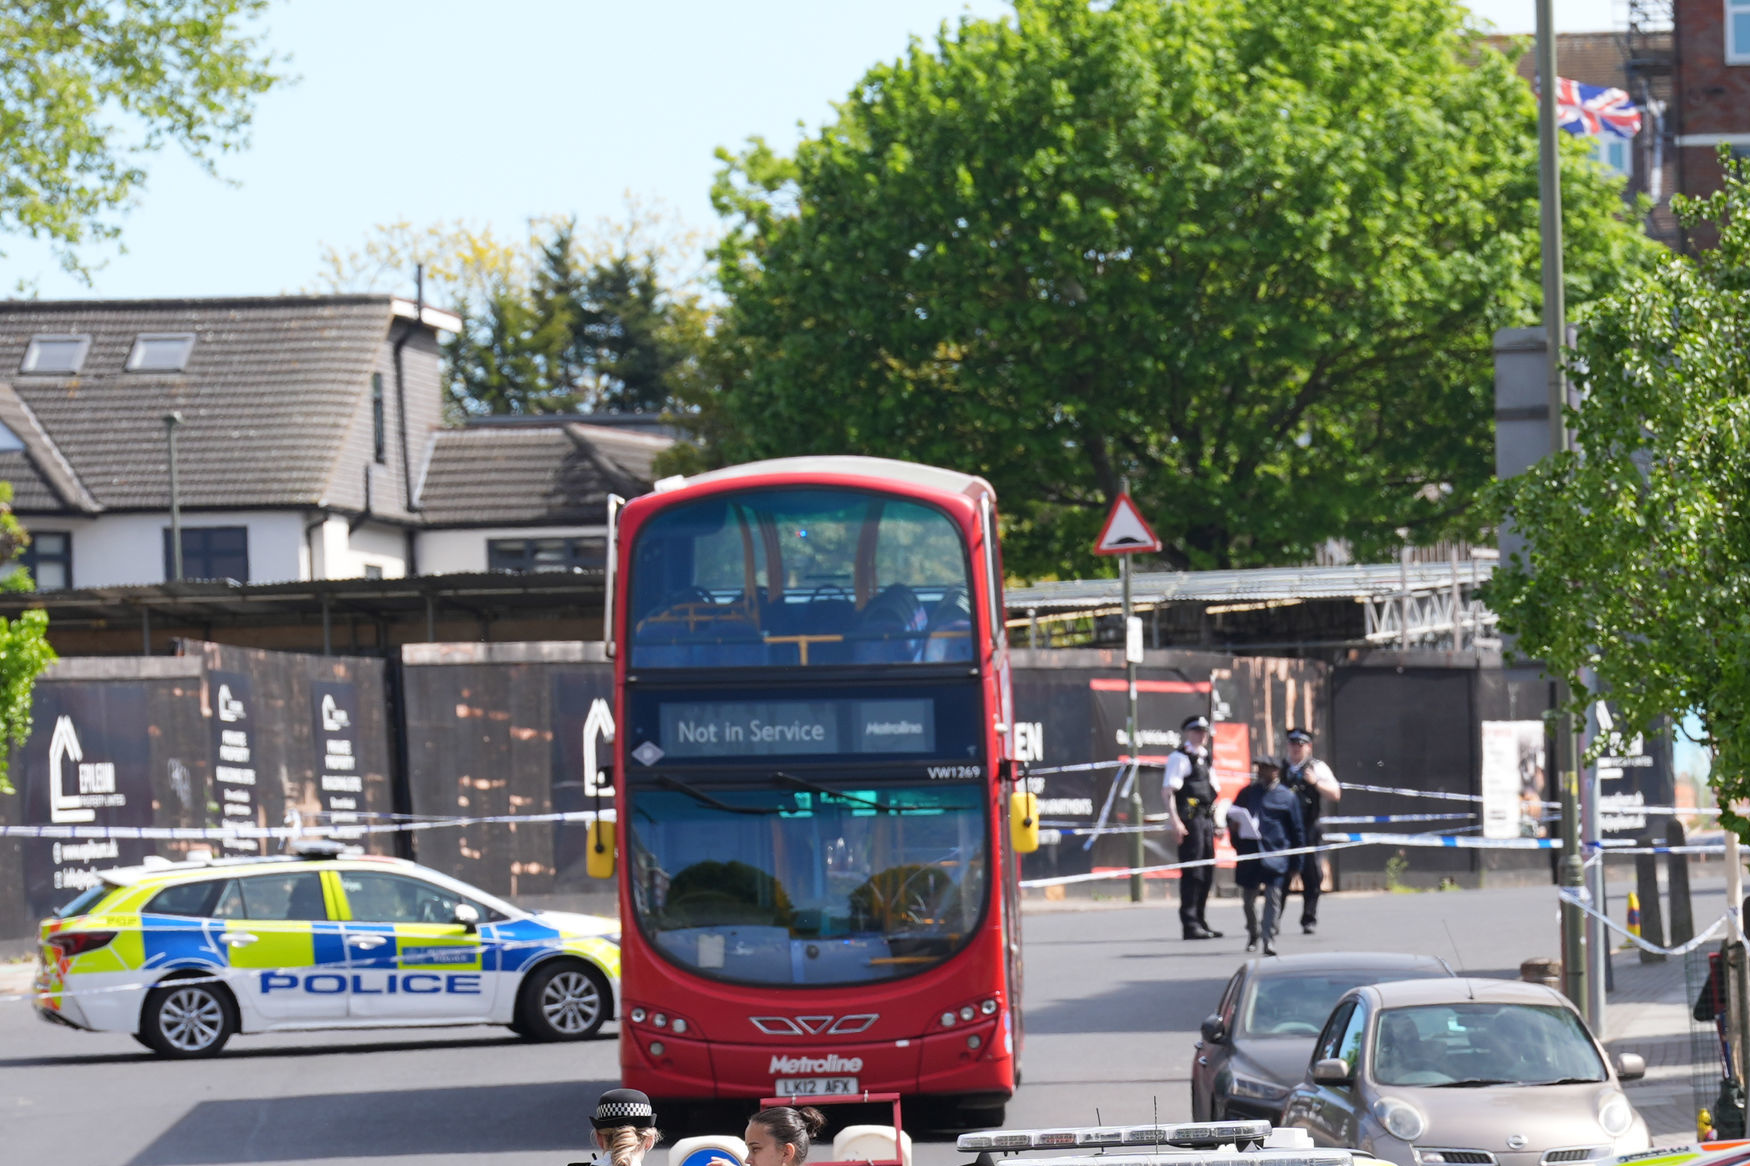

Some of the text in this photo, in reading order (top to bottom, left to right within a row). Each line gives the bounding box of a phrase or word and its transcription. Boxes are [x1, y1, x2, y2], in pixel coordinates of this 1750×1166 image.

[677, 719, 825, 744] Not in Service
[927, 765, 981, 780] VW1269
[260, 973, 481, 995] POLICE
[768, 1054, 864, 1074] Metroline
[783, 1080, 851, 1094] LK12 AFX
